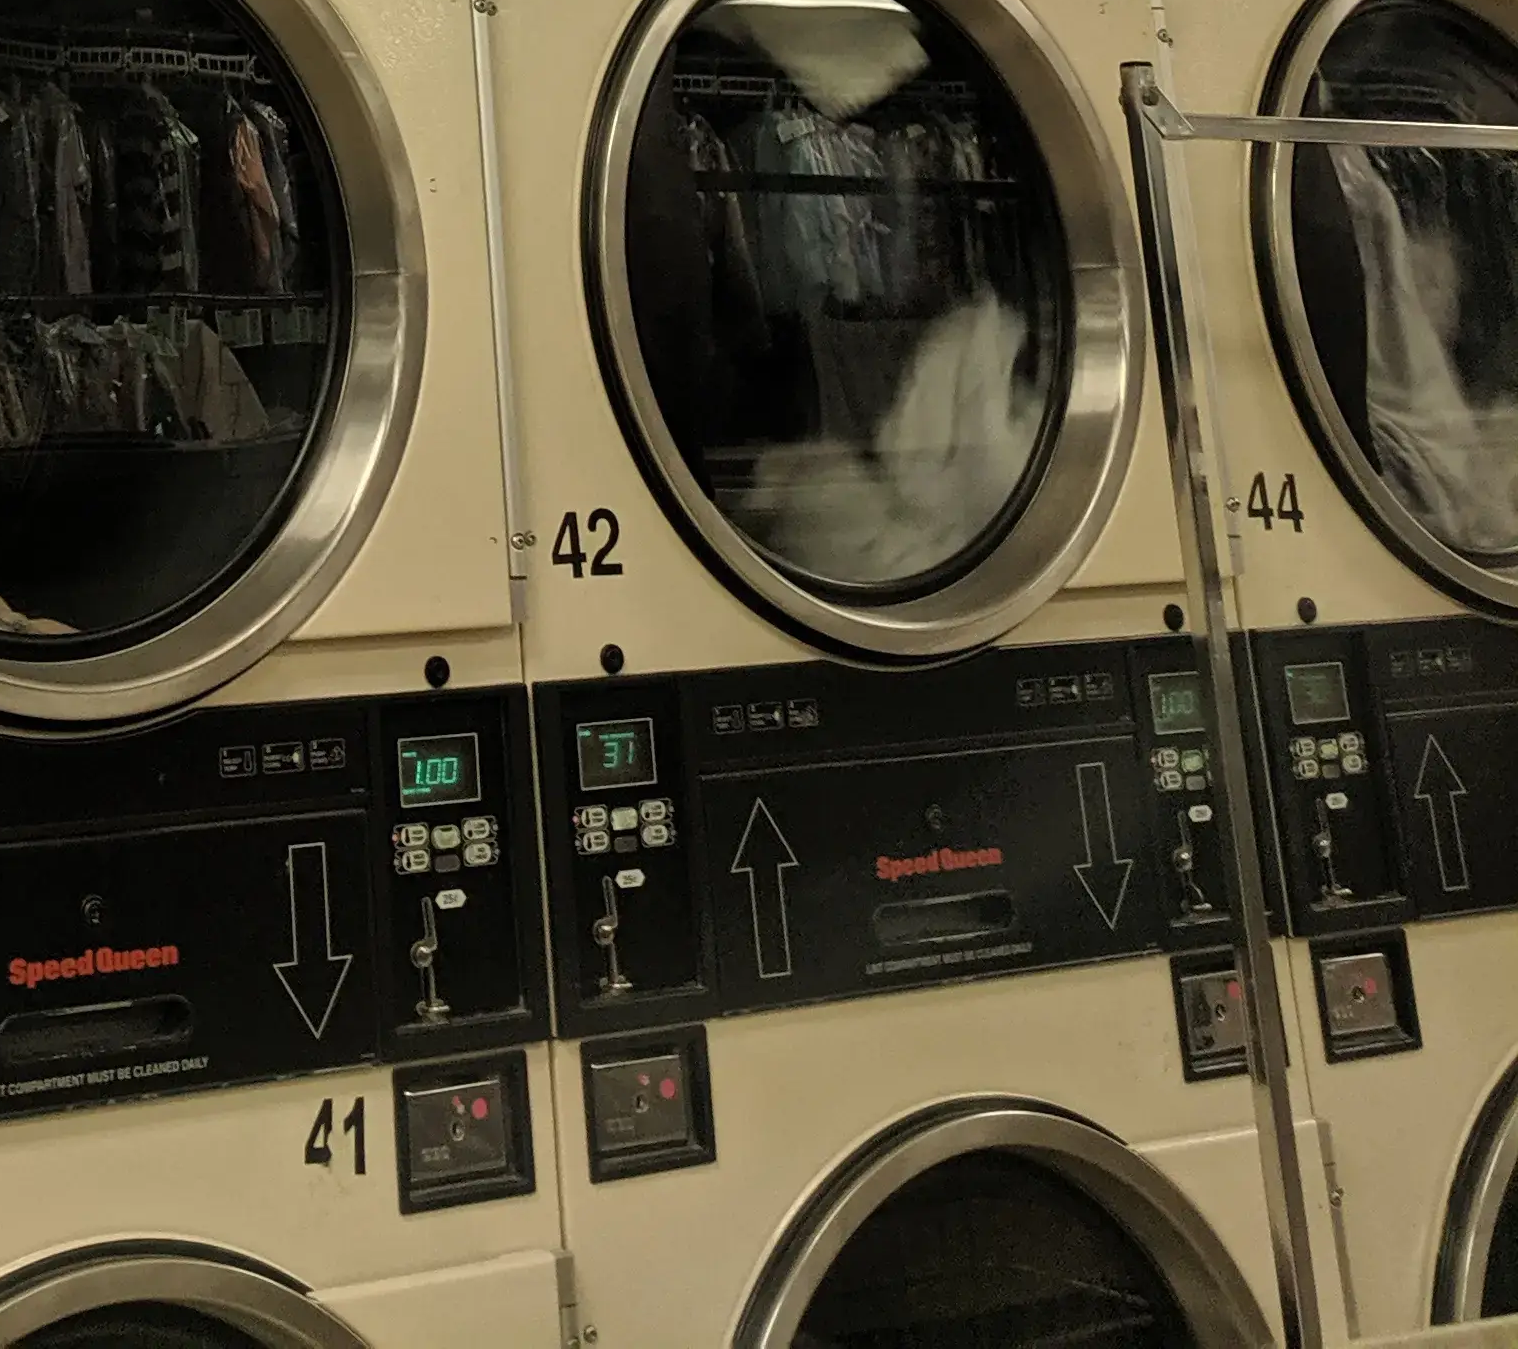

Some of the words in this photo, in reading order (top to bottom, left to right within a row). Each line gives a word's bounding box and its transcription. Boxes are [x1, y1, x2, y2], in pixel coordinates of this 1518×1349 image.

[1247, 471, 1304, 533] 44
[551, 508, 624, 579] 42
[9, 949, 94, 989] Speed
[96, 945, 179, 973] Queen
[9, 1073, 85, 1096] COMPARTMENT
[87, 1069, 114, 1084] MUST
[117, 1066, 131, 1080] BE
[133, 1060, 180, 1078] CLEANED
[304, 1096, 366, 1175] 41
